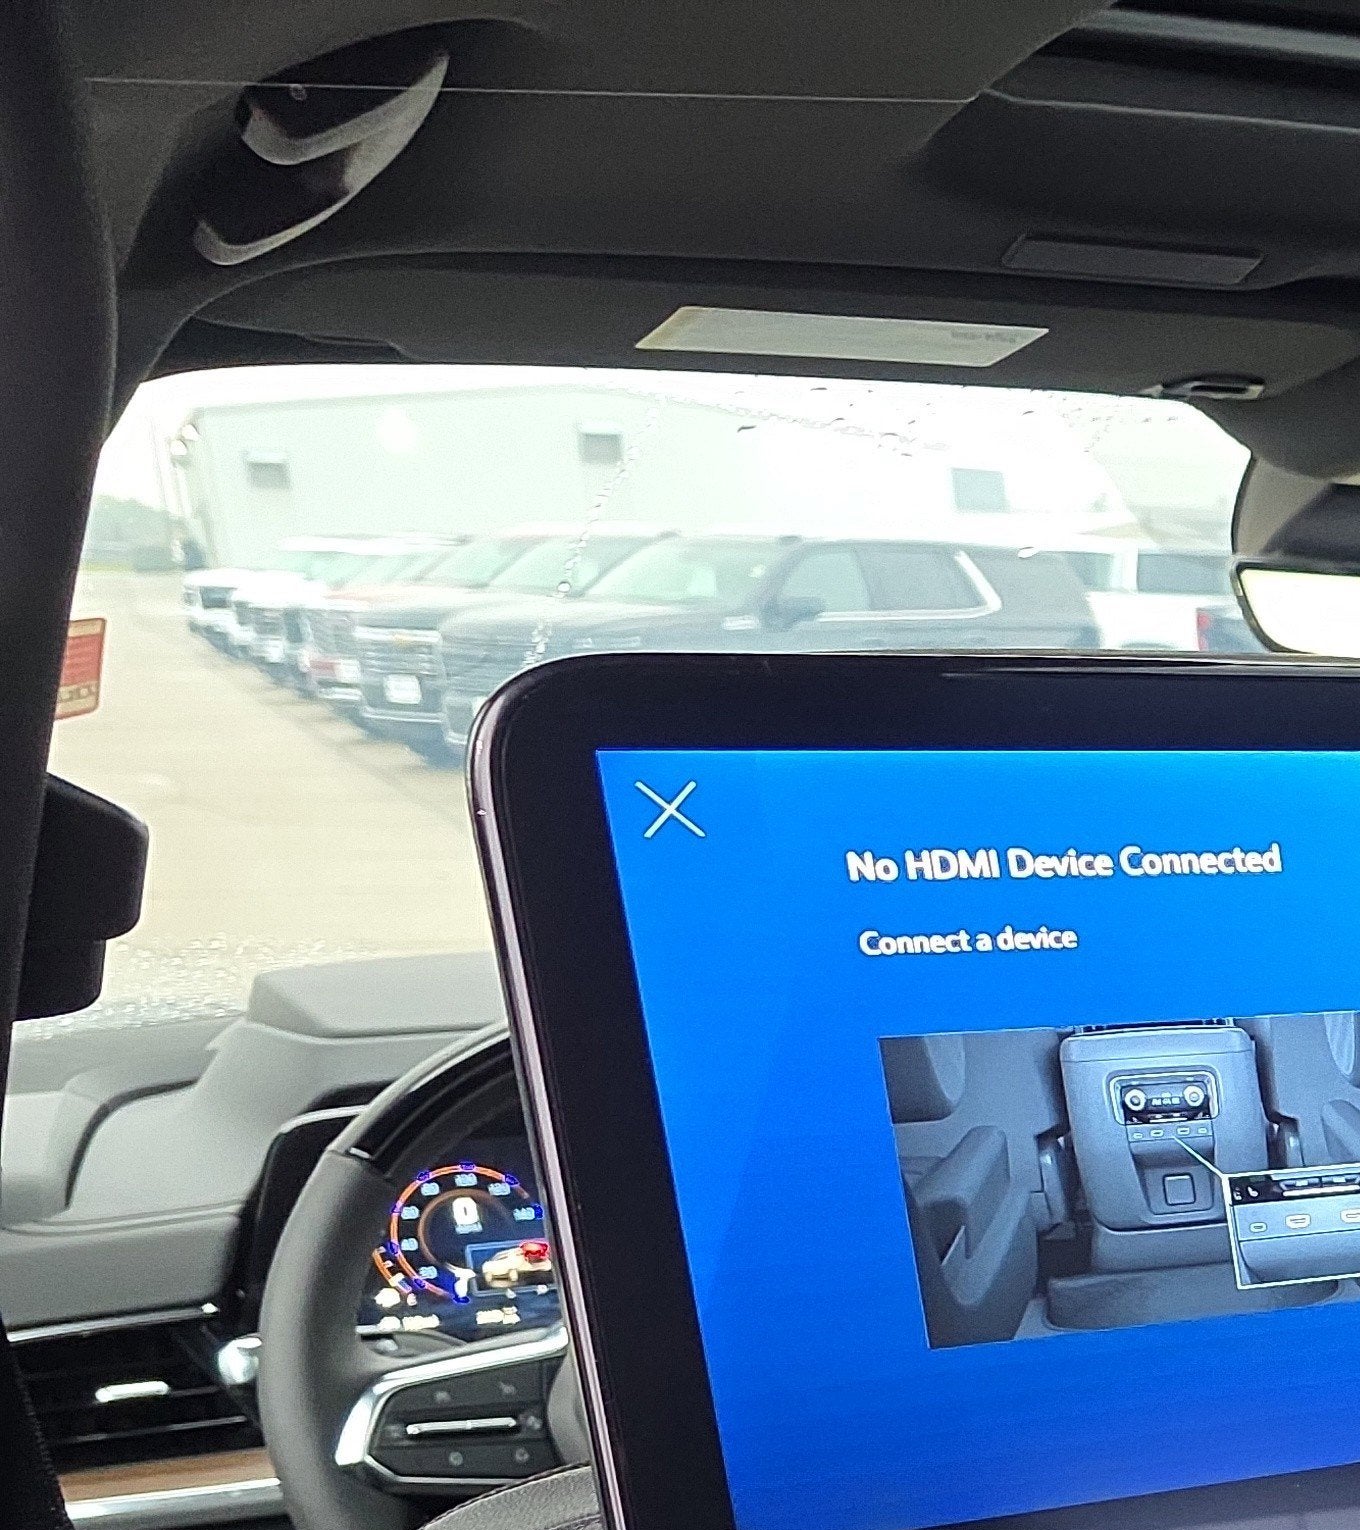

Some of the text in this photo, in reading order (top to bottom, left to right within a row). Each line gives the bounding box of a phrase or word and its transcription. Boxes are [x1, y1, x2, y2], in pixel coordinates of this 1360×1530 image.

[846, 843, 1283, 881] No HDMI Device Connected
[859, 924, 1078, 956] Connect a device
